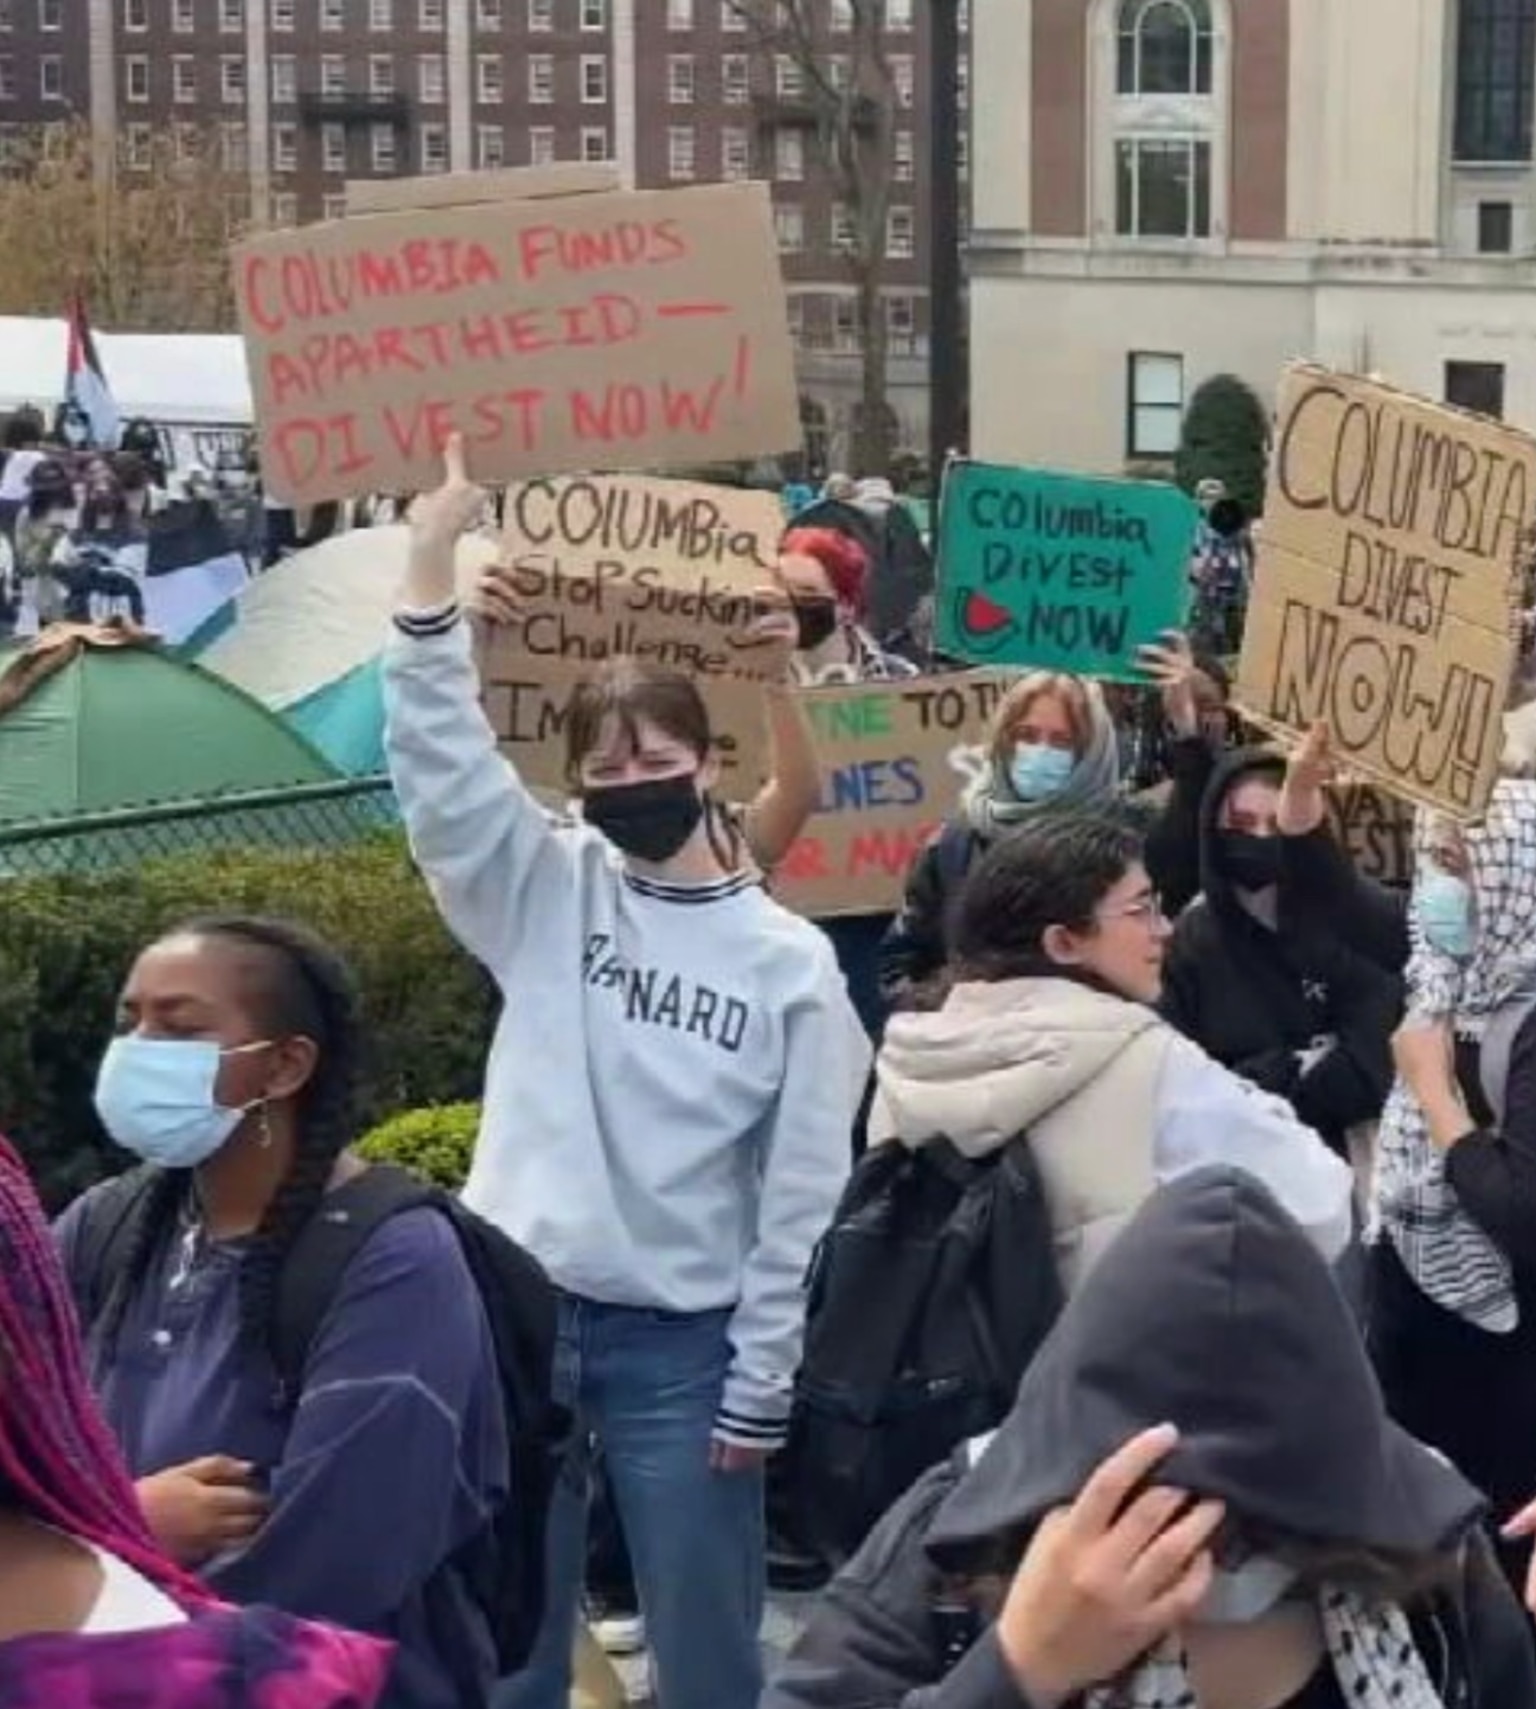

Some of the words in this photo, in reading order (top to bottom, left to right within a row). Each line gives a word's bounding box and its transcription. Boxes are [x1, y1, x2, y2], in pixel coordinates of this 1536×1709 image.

[245, 237, 501, 334] COLUMBIA
[517, 218, 688, 280] FUNDS
[266, 293, 641, 403] APARTHEID
[1279, 385, 1529, 562] COLUMBIA
[1026, 594, 1132, 656] NOW
[1338, 530, 1465, 641] DIVEST
